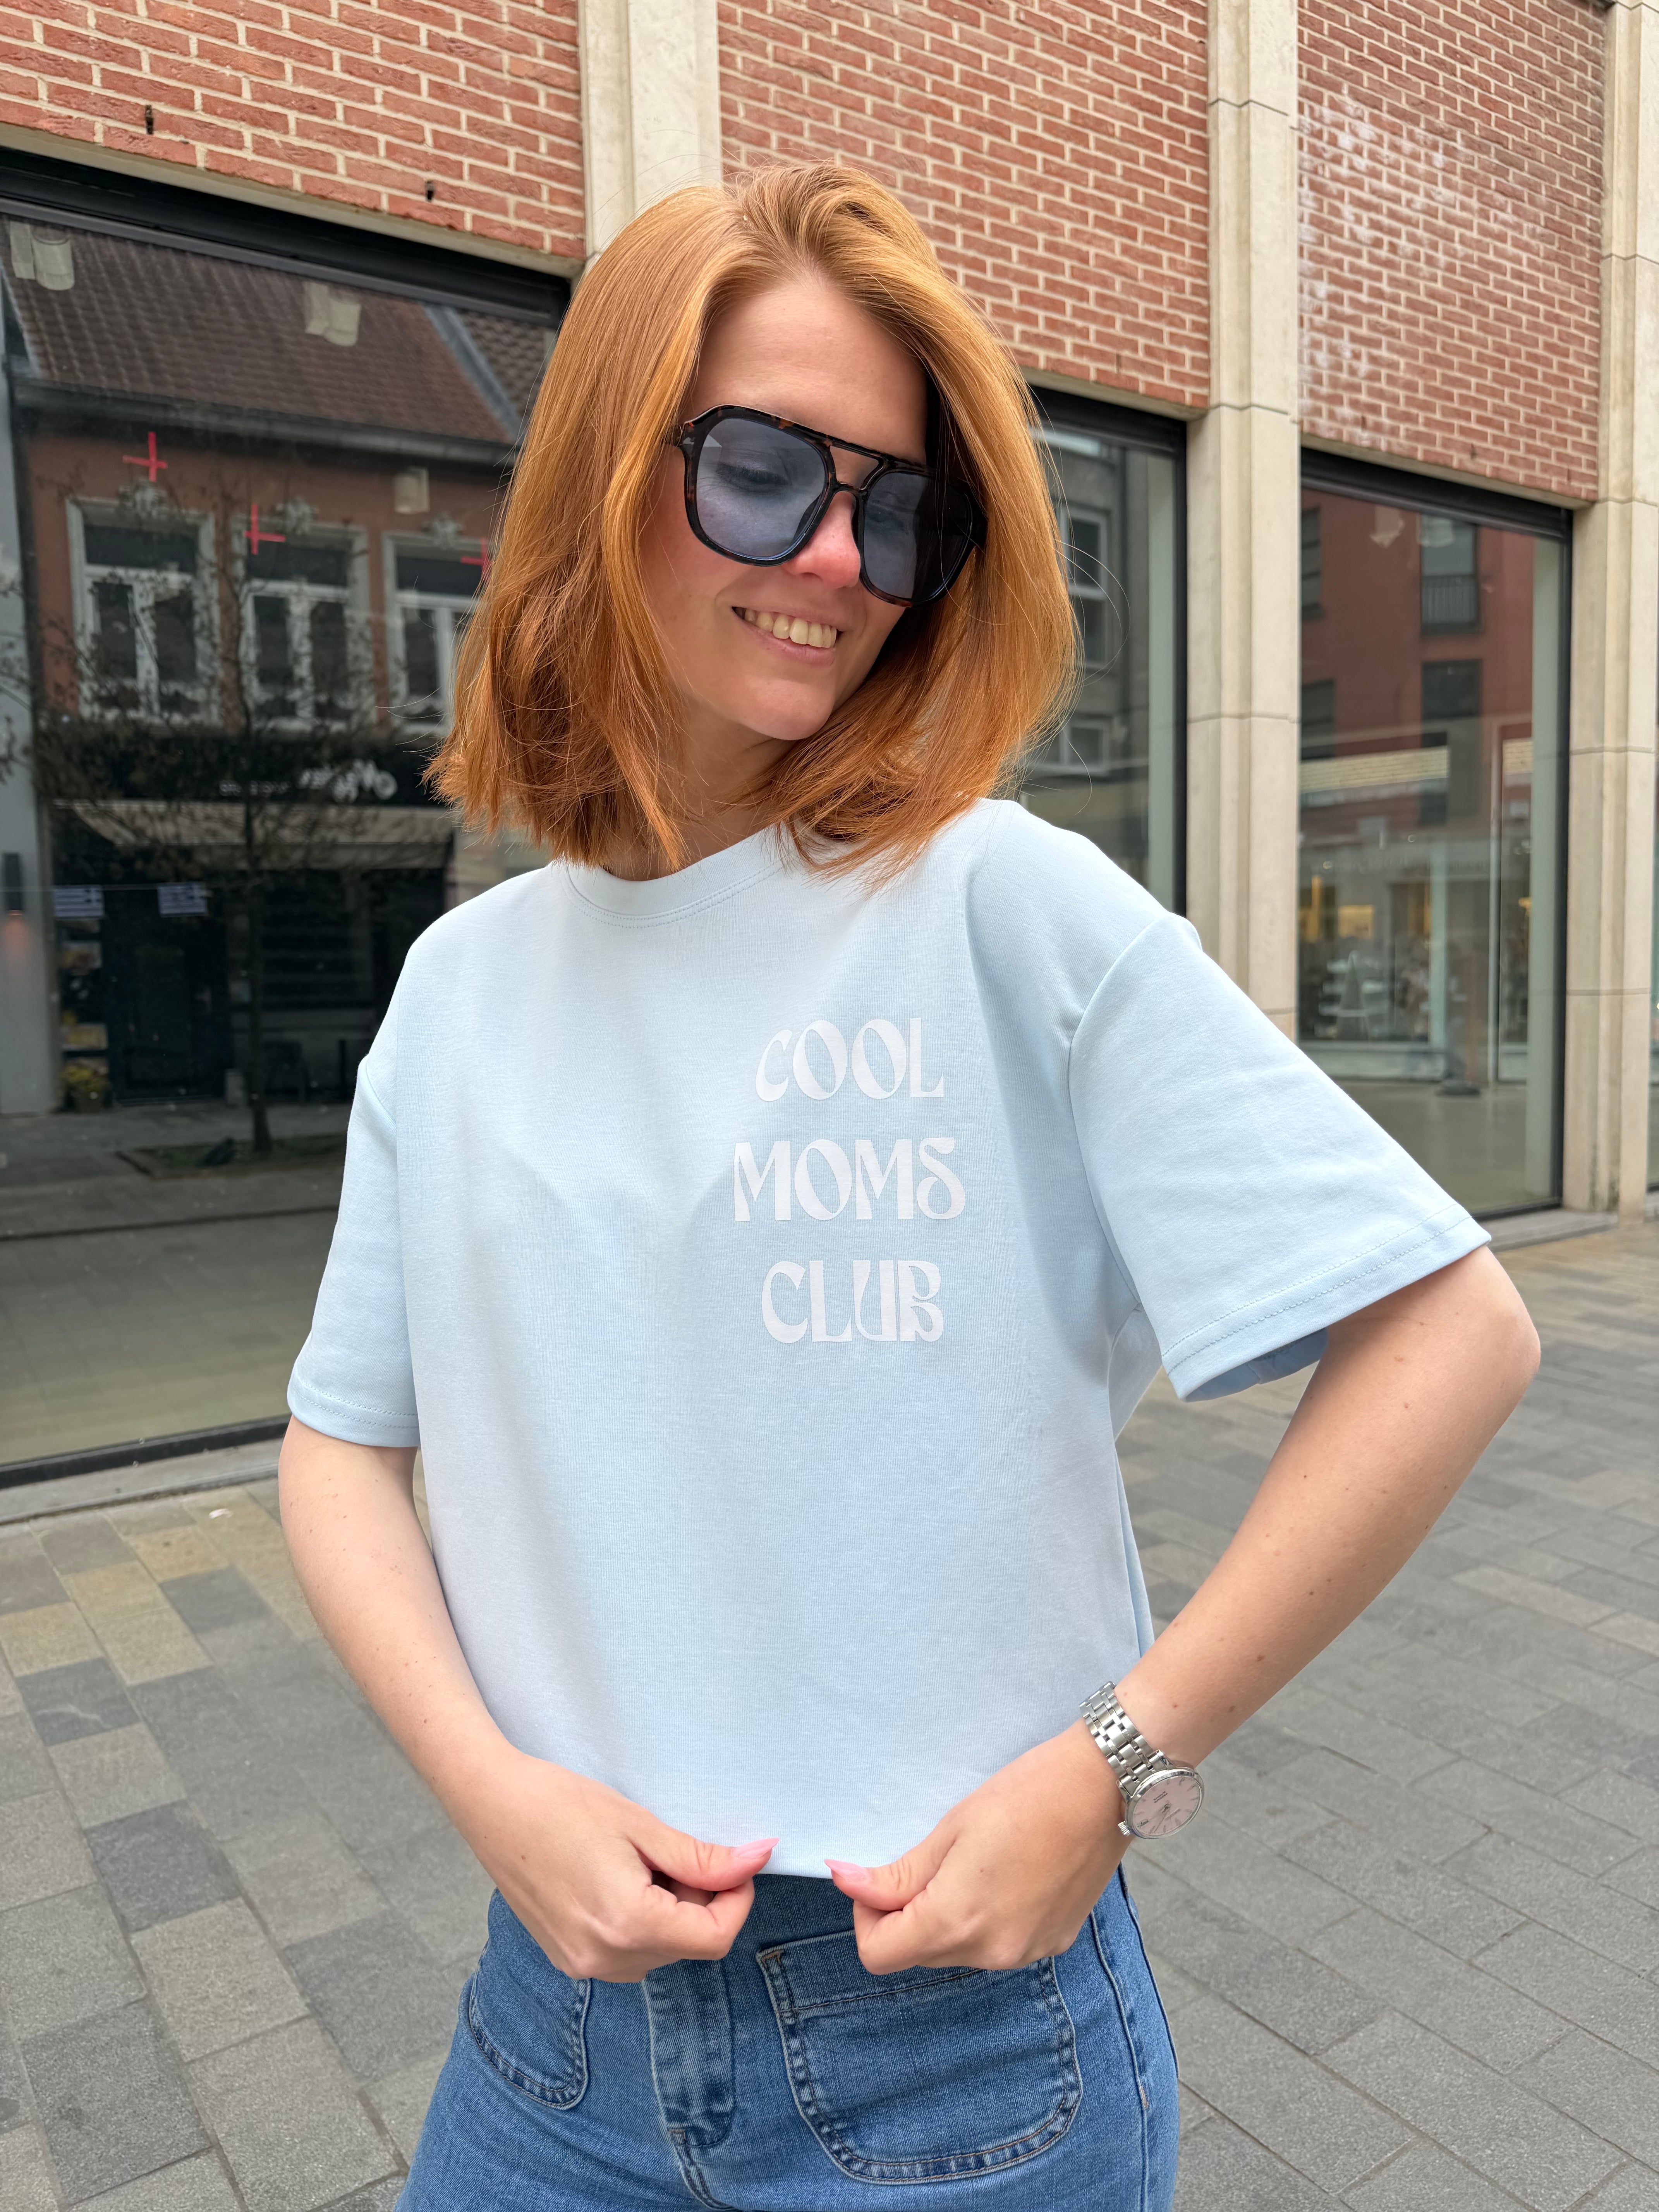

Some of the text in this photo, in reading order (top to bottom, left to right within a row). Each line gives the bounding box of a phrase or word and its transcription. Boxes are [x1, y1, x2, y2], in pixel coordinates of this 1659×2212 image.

[756, 1018, 944, 1101] COOL
[734, 1137, 965, 1221] MOMS
[762, 1261, 944, 1343] CLUB
